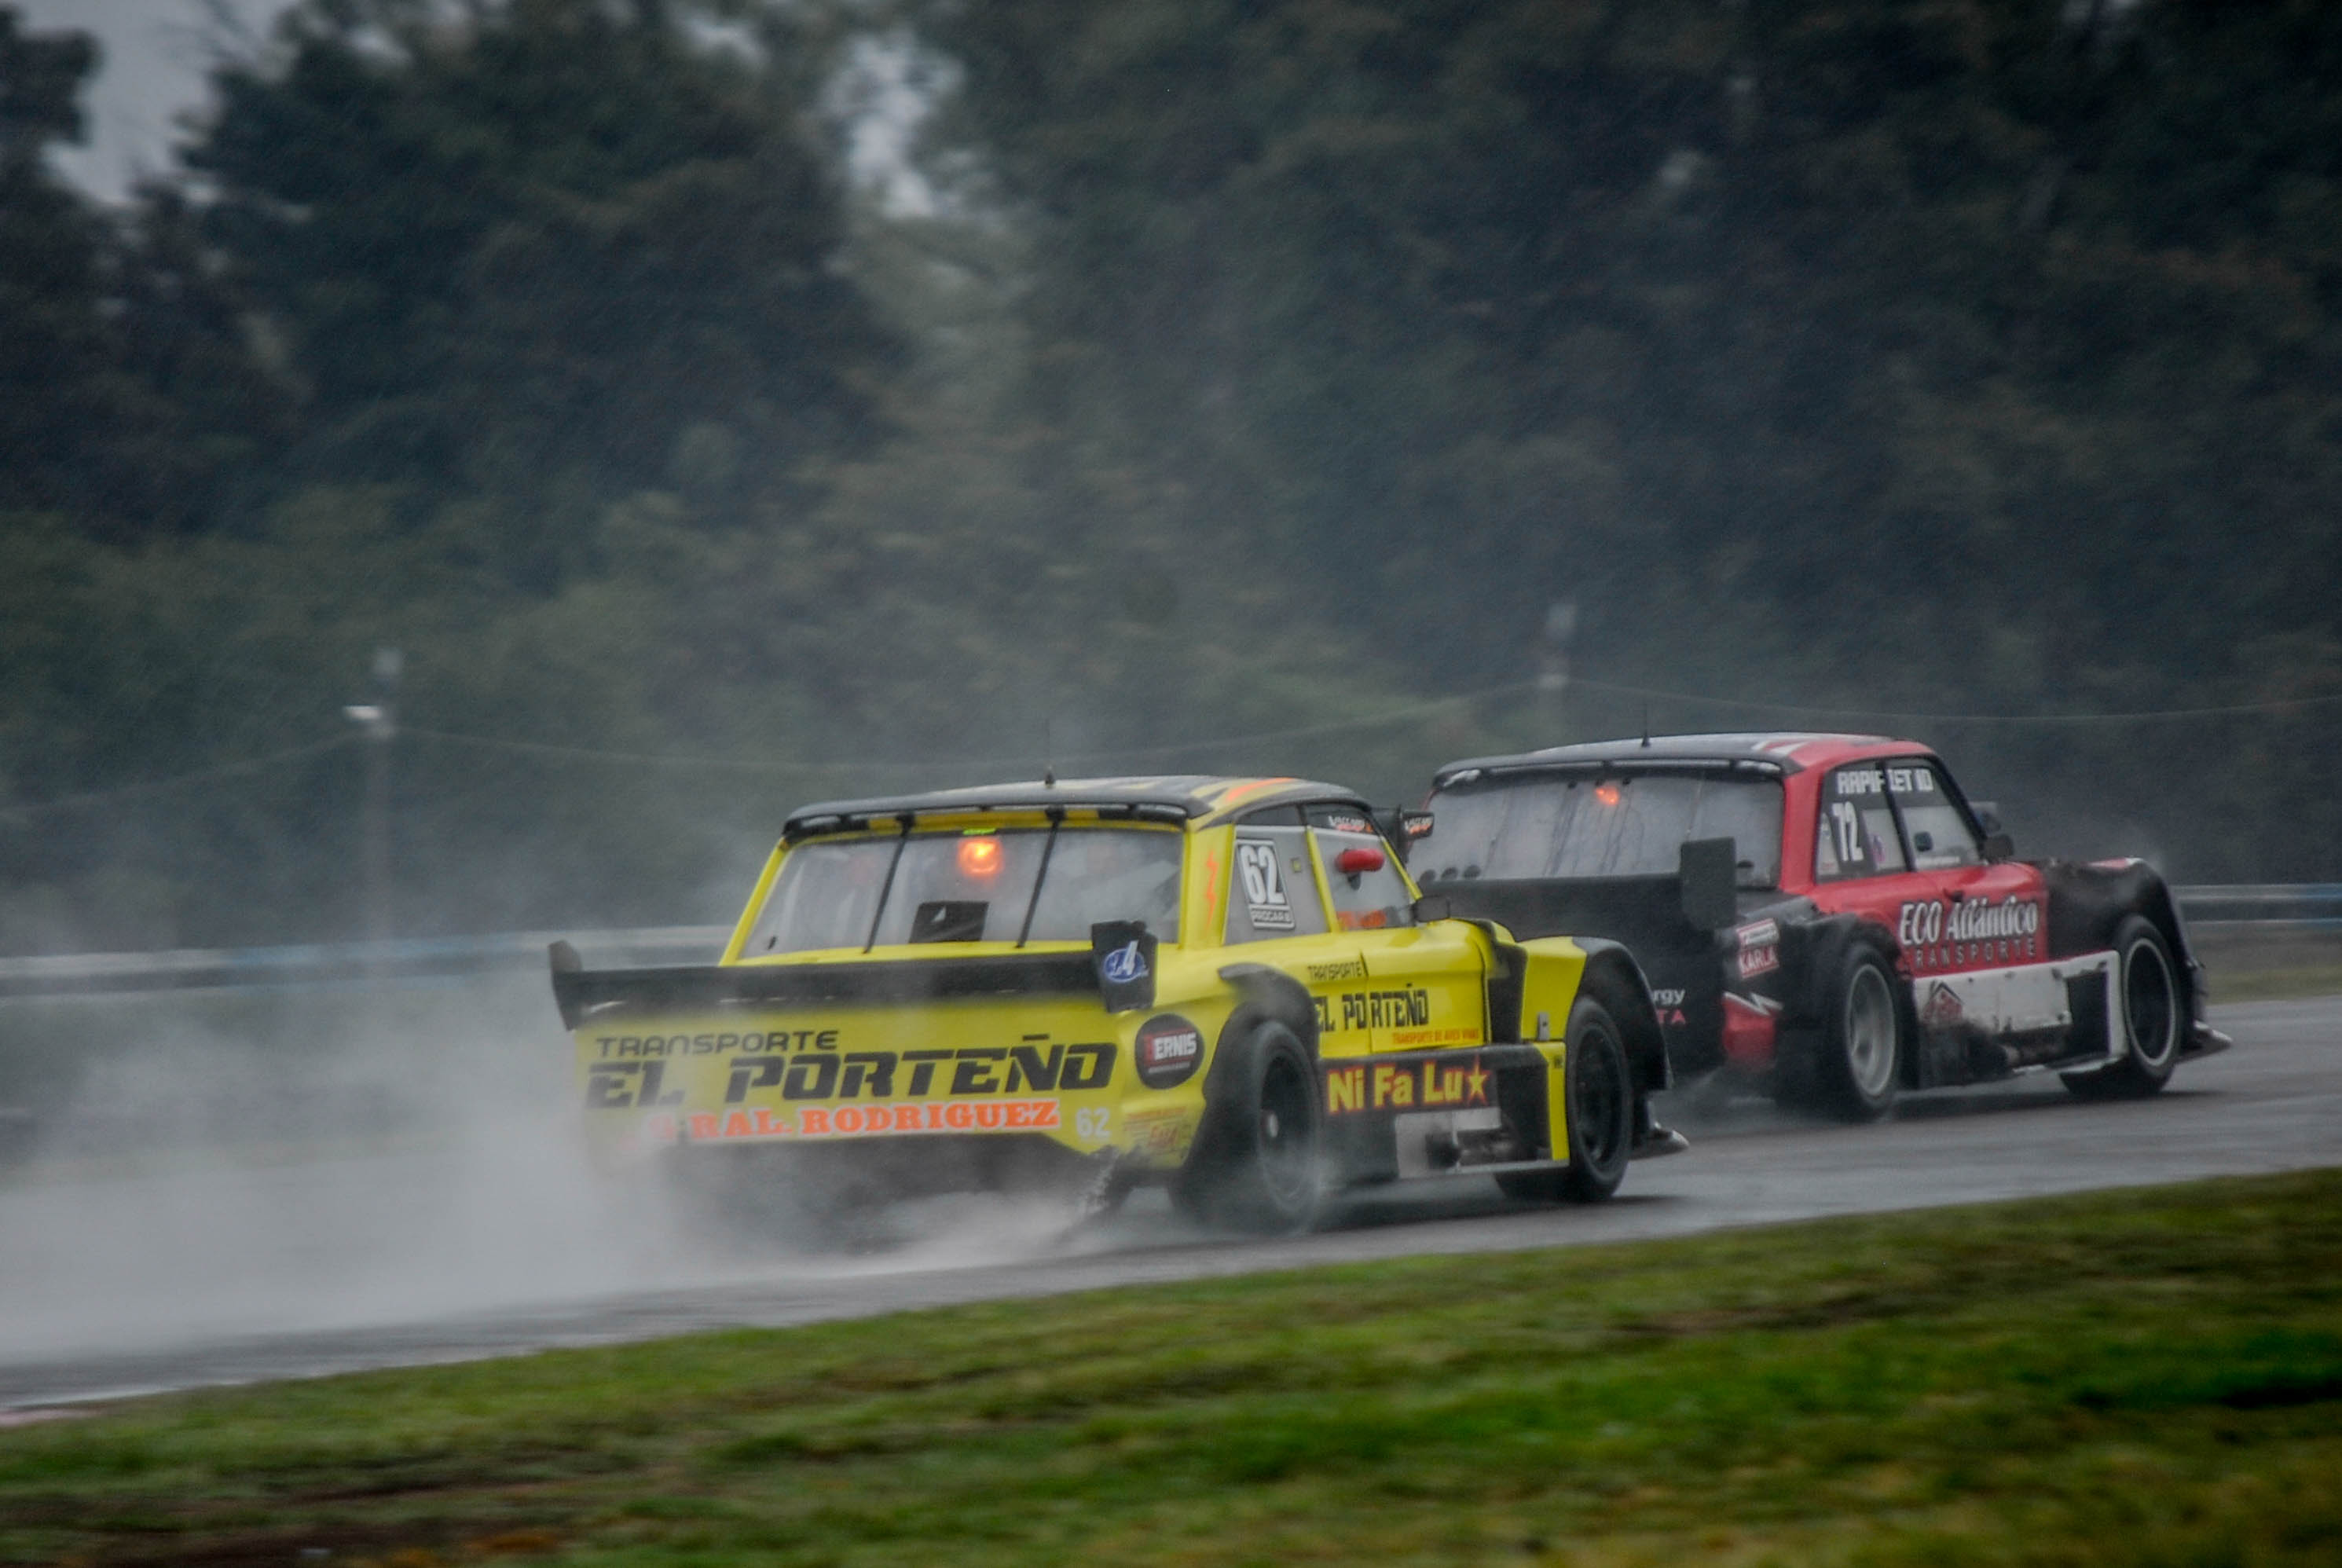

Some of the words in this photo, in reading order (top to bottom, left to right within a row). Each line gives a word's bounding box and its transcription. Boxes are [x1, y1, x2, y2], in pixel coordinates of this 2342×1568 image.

[1239, 845, 1287, 903] 62
[1900, 901, 1943, 946] ECO
[1307, 961, 1362, 981] TRANSPORTE
[1901, 937, 2036, 973] RANSPORTE
[1342, 983, 1429, 1031] PORTEÑO
[596, 1030, 839, 1057] TRANSPORTE
[585, 1059, 685, 1110] EL
[723, 1033, 1118, 1104] PORTEÑO
[1328, 1066, 1365, 1114] Ni
[1374, 1064, 1414, 1108] Fa
[1423, 1061, 1464, 1104] Lu
[801, 1100, 1060, 1135] RODRIGUEZ
[1076, 1108, 1112, 1138] 62
